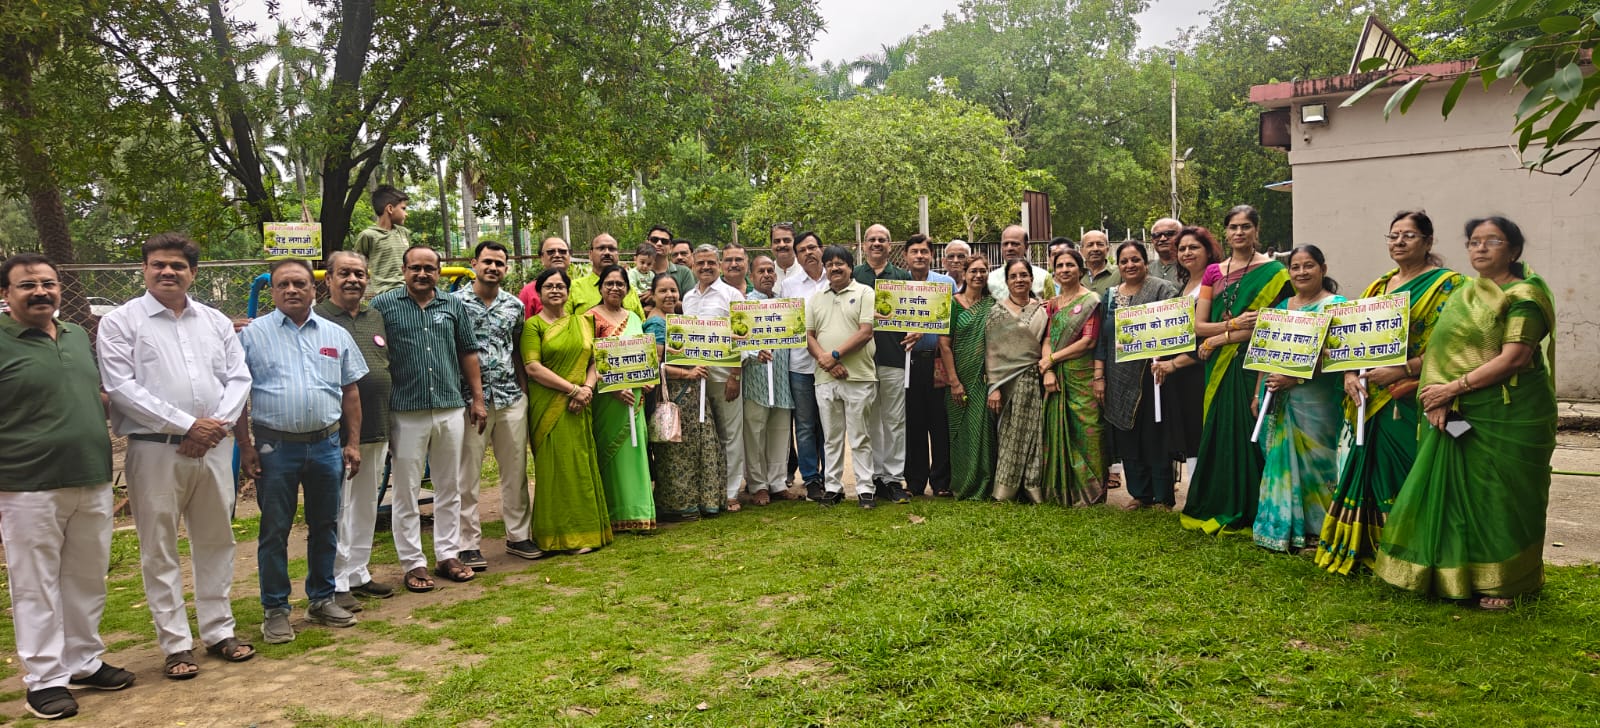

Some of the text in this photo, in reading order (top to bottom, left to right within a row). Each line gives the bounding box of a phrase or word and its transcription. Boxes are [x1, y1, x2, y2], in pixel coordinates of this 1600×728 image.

[909, 306, 915, 316] से
[1122, 323, 1147, 336] प्रदूषण
[1150, 316, 1161, 329] को
[1330, 313, 1402, 340] प्रदूषण को हराओ
[708, 331, 719, 344] और
[1272, 328, 1280, 340] को
[1123, 331, 1189, 352] धरती को बचाओ
[1330, 338, 1400, 359] धरती को बचाओ
[621, 350, 646, 364] लगाओ
[685, 346, 700, 357] धरती
[603, 370, 624, 384] जीवन
